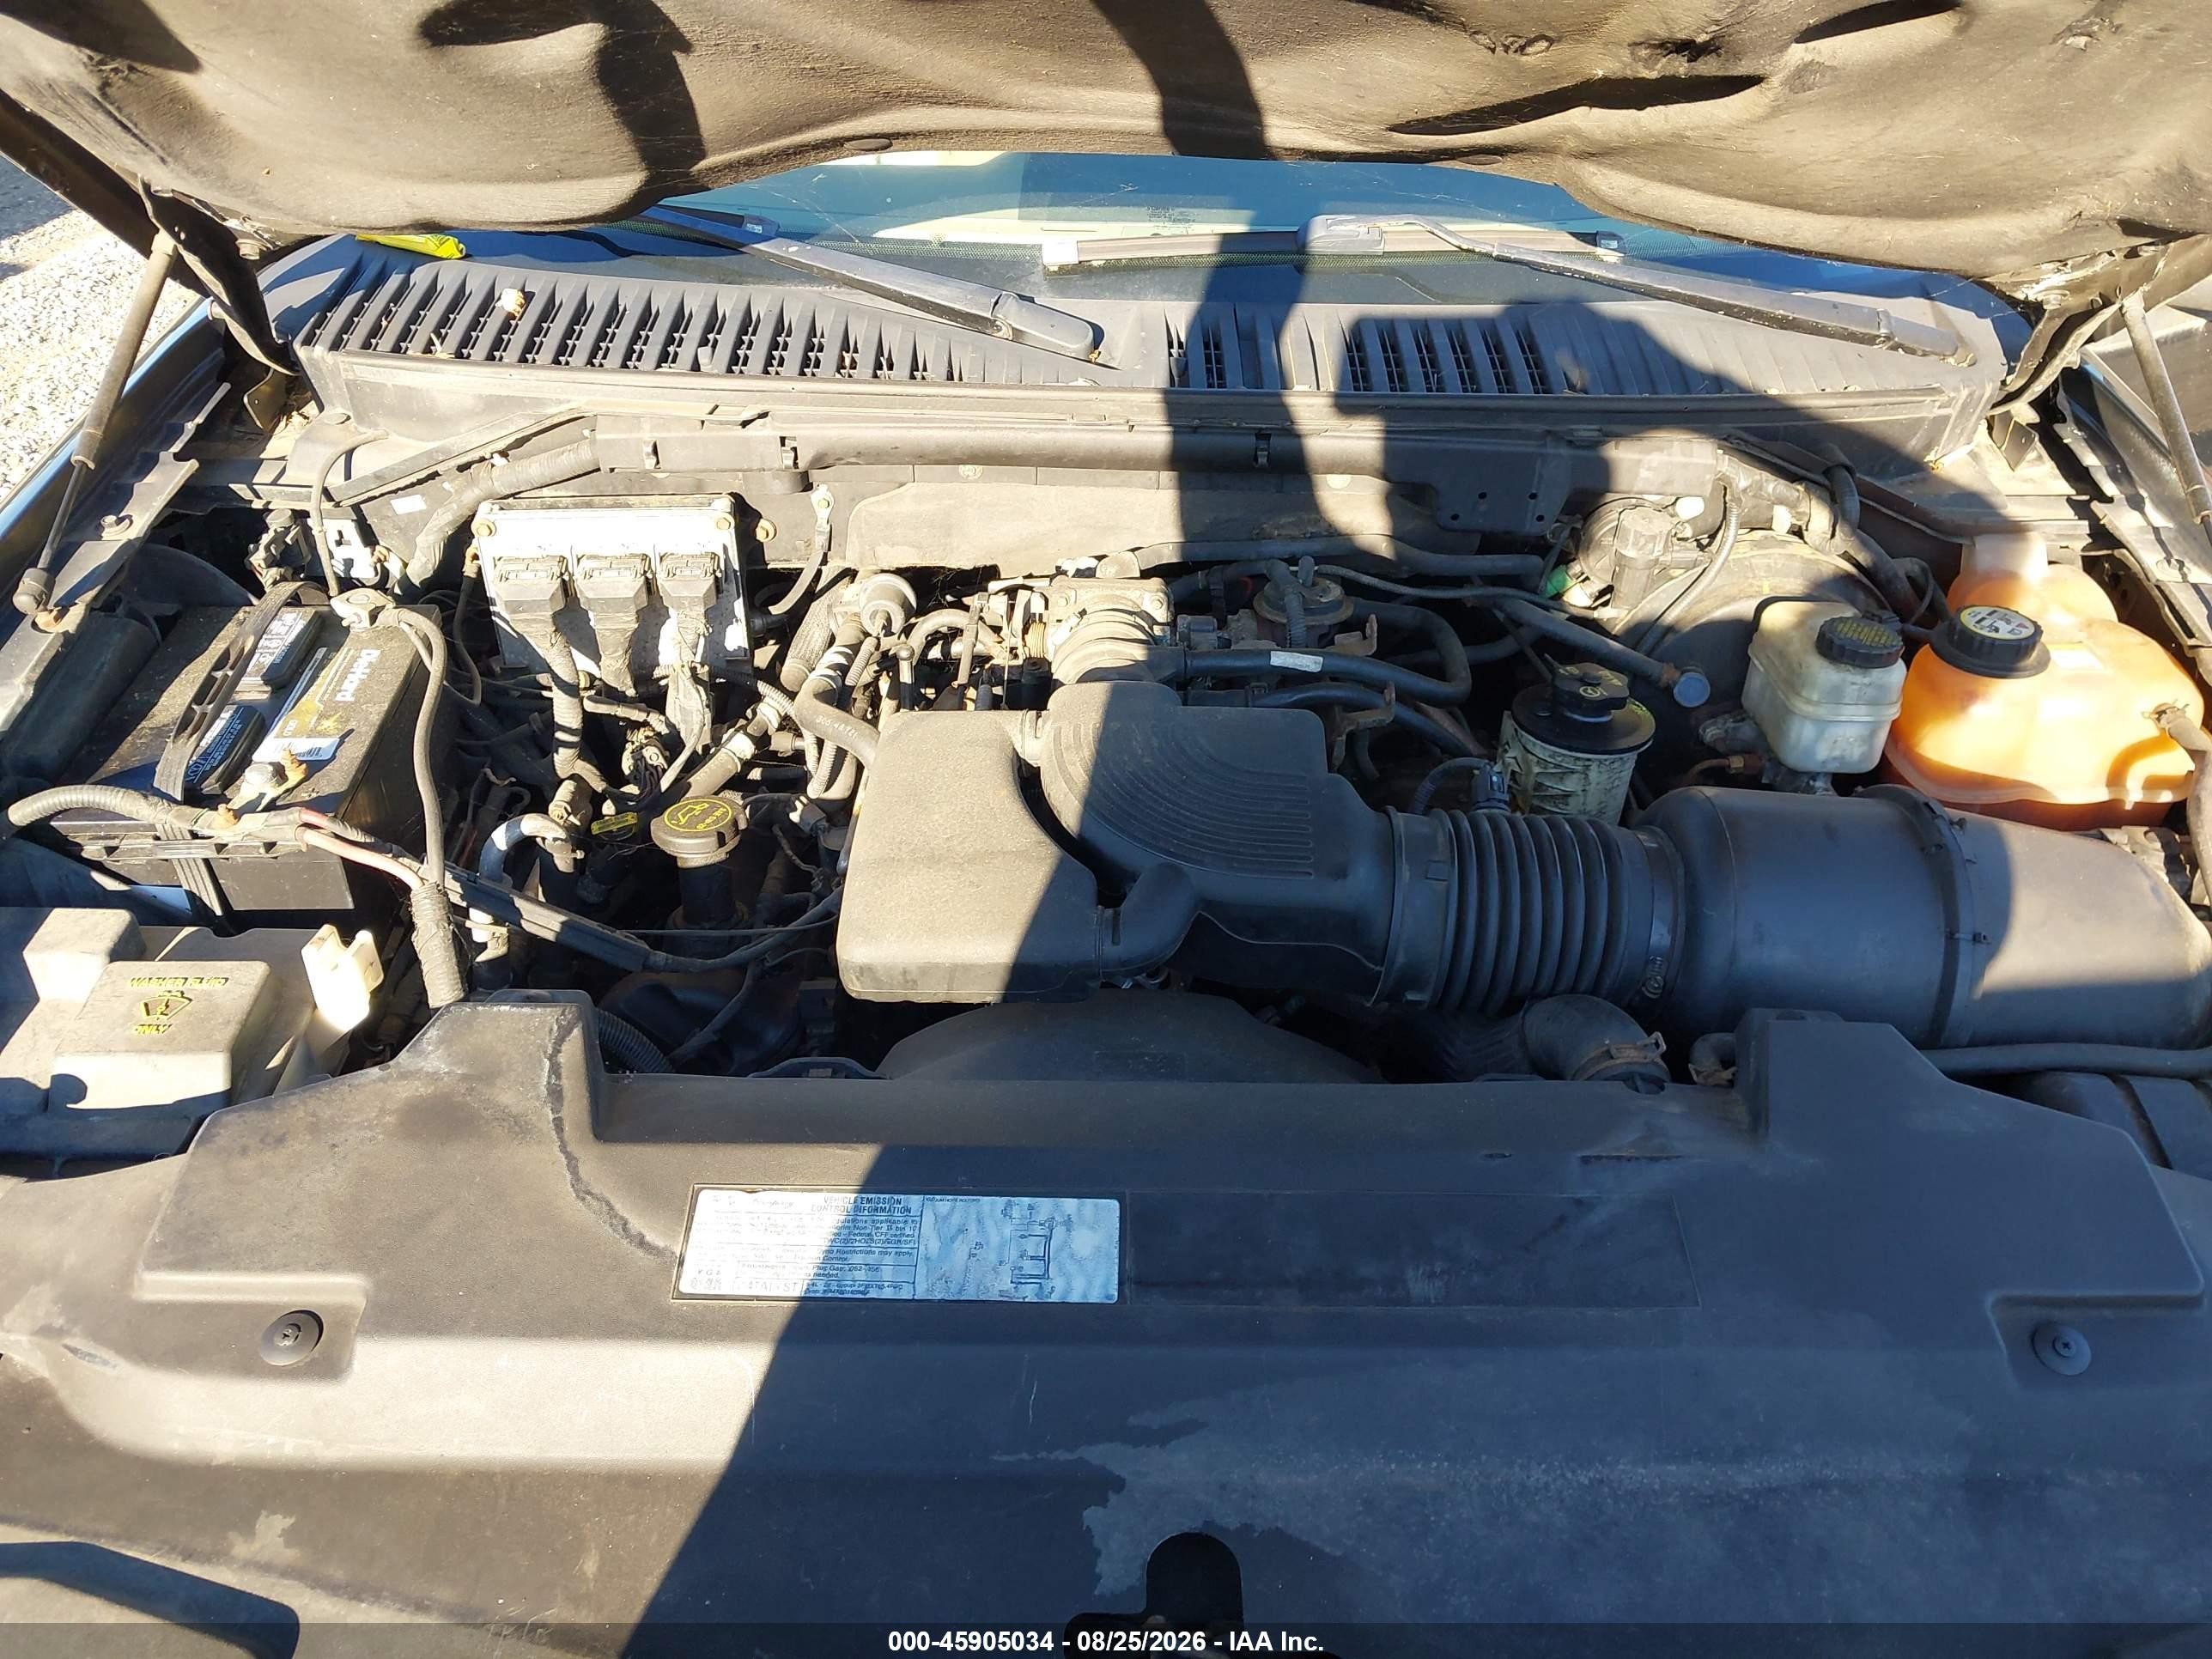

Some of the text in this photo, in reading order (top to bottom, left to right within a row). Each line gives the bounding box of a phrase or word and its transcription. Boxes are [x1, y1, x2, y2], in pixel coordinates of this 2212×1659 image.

[334, 648, 382, 702] DieHard
[130, 976, 189, 988] WASHER
[823, 1195, 902, 1206] VEHICLE EMISSION
[811, 1204, 912, 1214] CONTROL INFORMATION
